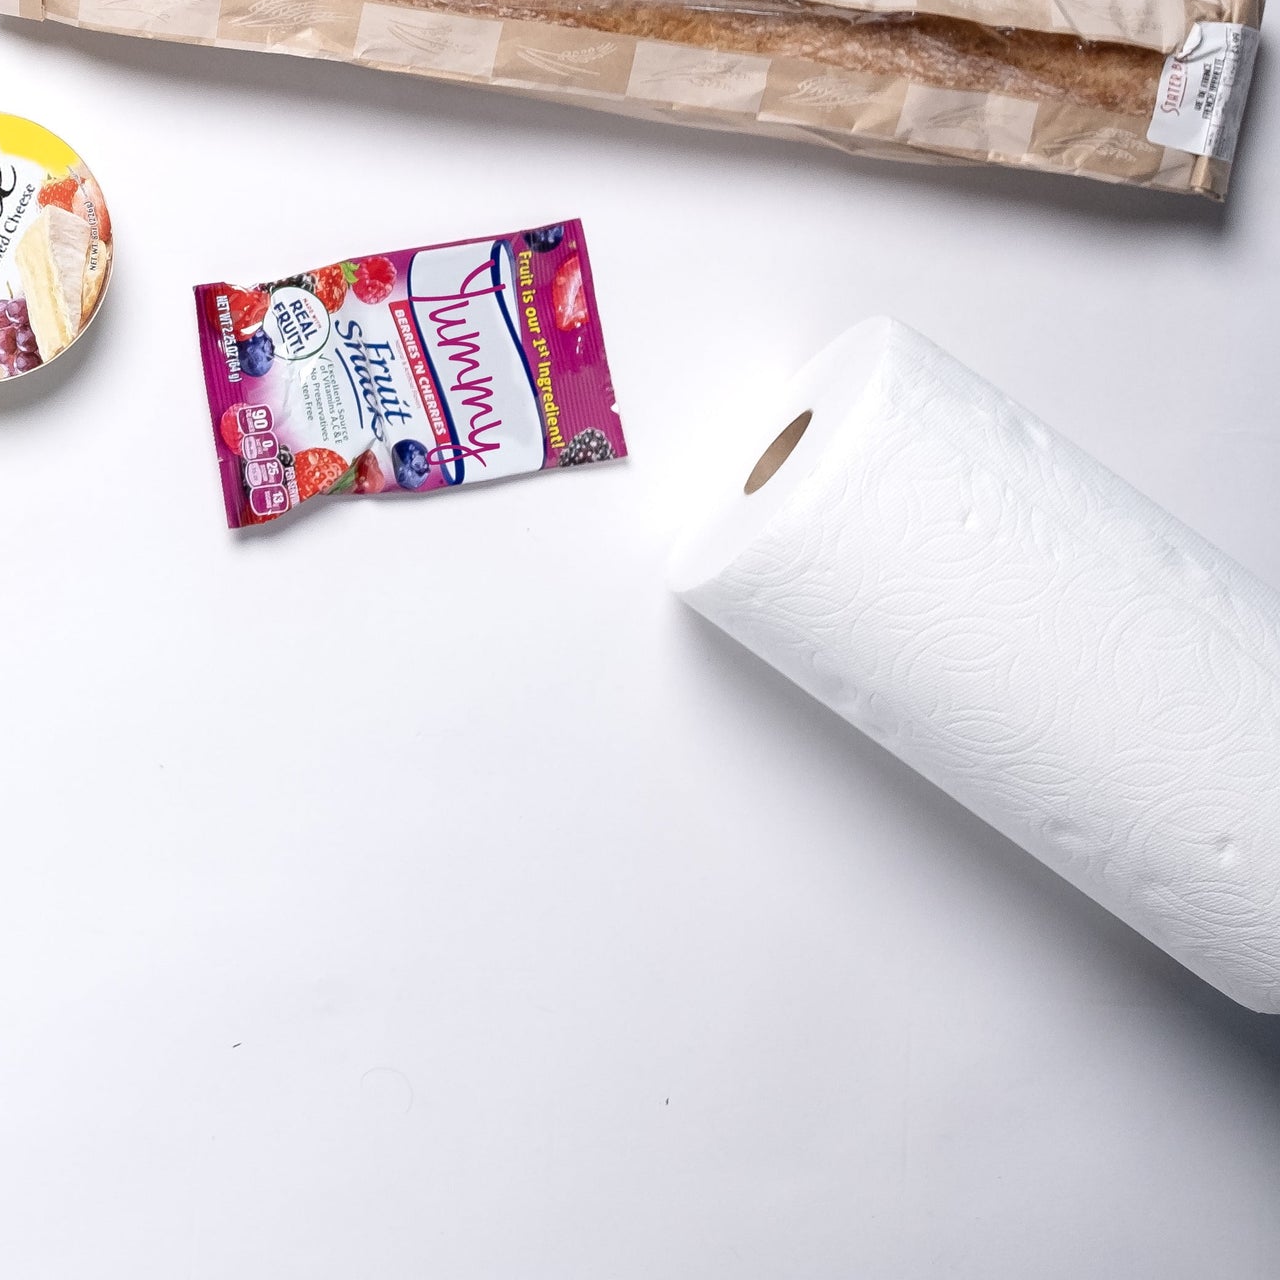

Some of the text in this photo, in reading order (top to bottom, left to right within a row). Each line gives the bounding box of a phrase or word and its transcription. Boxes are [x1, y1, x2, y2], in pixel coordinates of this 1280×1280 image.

[3, 183, 36, 234] Cheese
[216, 295, 229, 310] NET
[274, 302, 304, 353] FRUIT!
[289, 299, 317, 342] REAL
[394, 309, 419, 359] BERRIES
[419, 376, 445, 437] CHERRIES
[409, 259, 505, 468] Yummy
[516, 250, 564, 447] Fruit is our 1st Ingredient!
[313, 382, 328, 441] Preservatives
[322, 376, 334, 413] Vitamins
[327, 363, 348, 440] Excellent Source
[366, 339, 413, 430] Fruit
